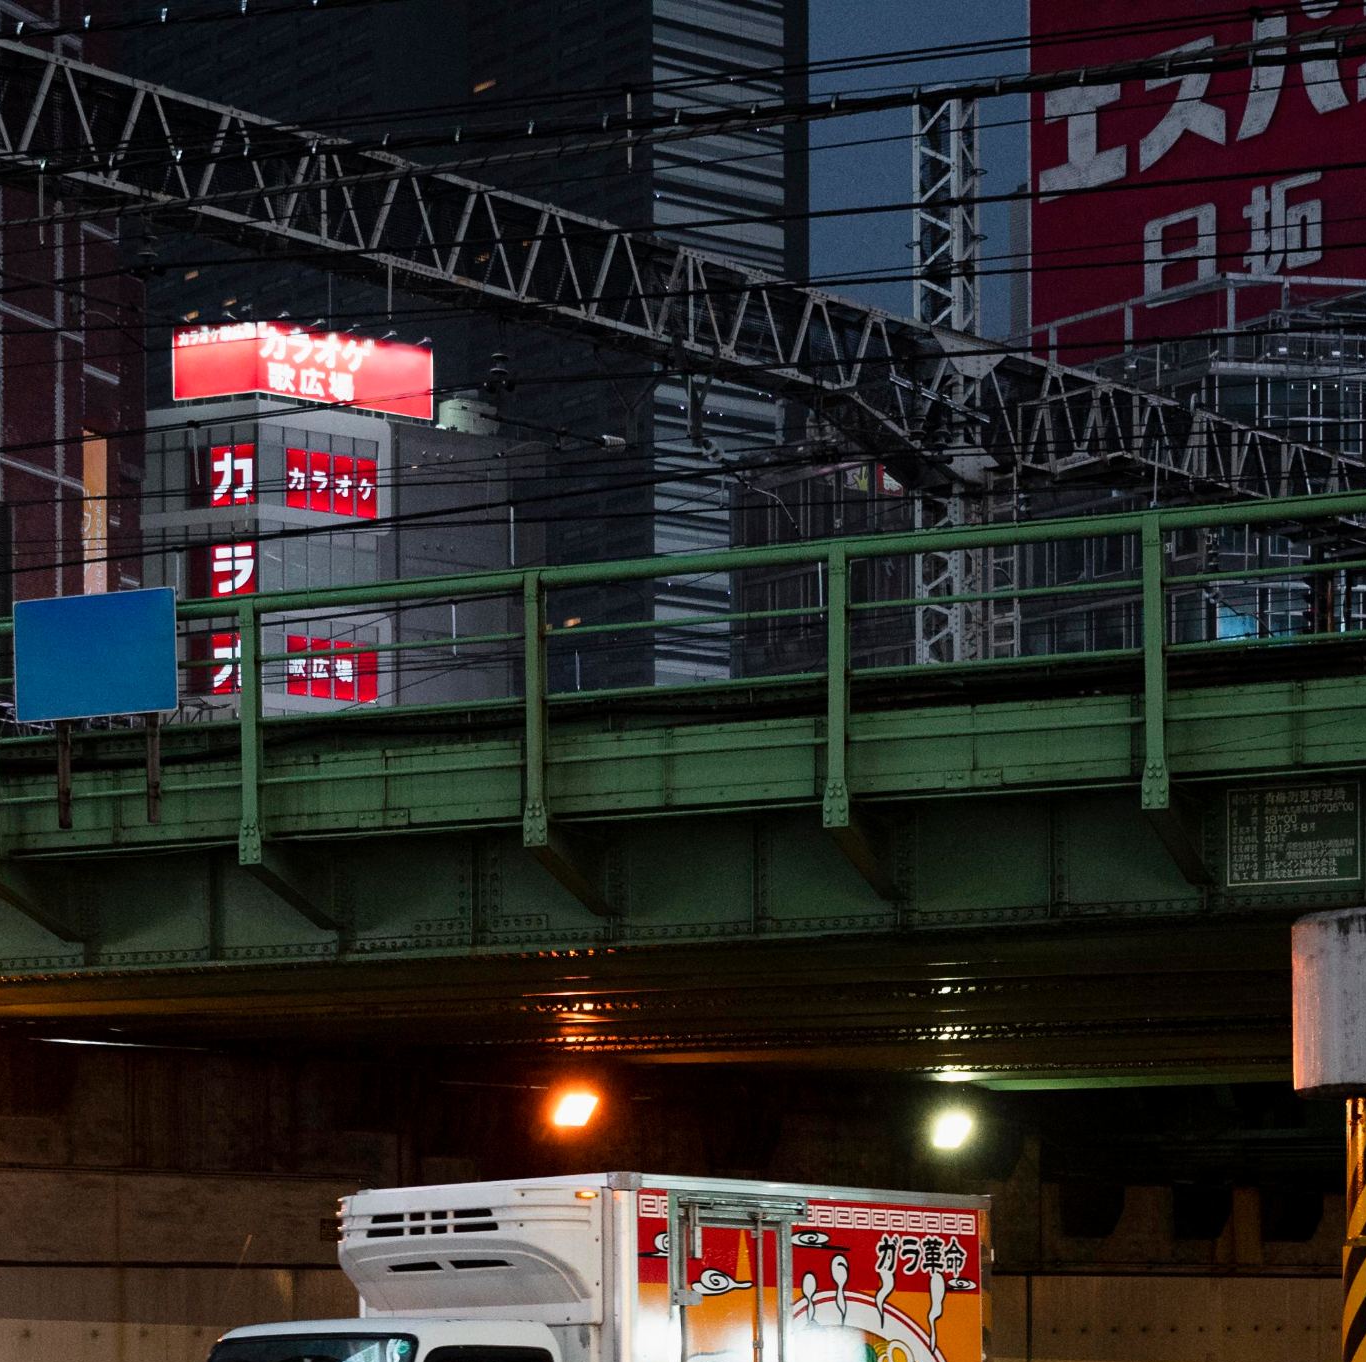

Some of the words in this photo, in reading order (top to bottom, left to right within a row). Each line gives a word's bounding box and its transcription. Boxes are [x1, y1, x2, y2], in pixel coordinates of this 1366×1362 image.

[259, 328, 375, 373] カラオケ
[267, 362, 354, 402] 歌広場
[287, 466, 376, 501] カラオケ
[288, 658, 353, 683] 歌広場
[876, 1233, 967, 1277] ガラ革命
